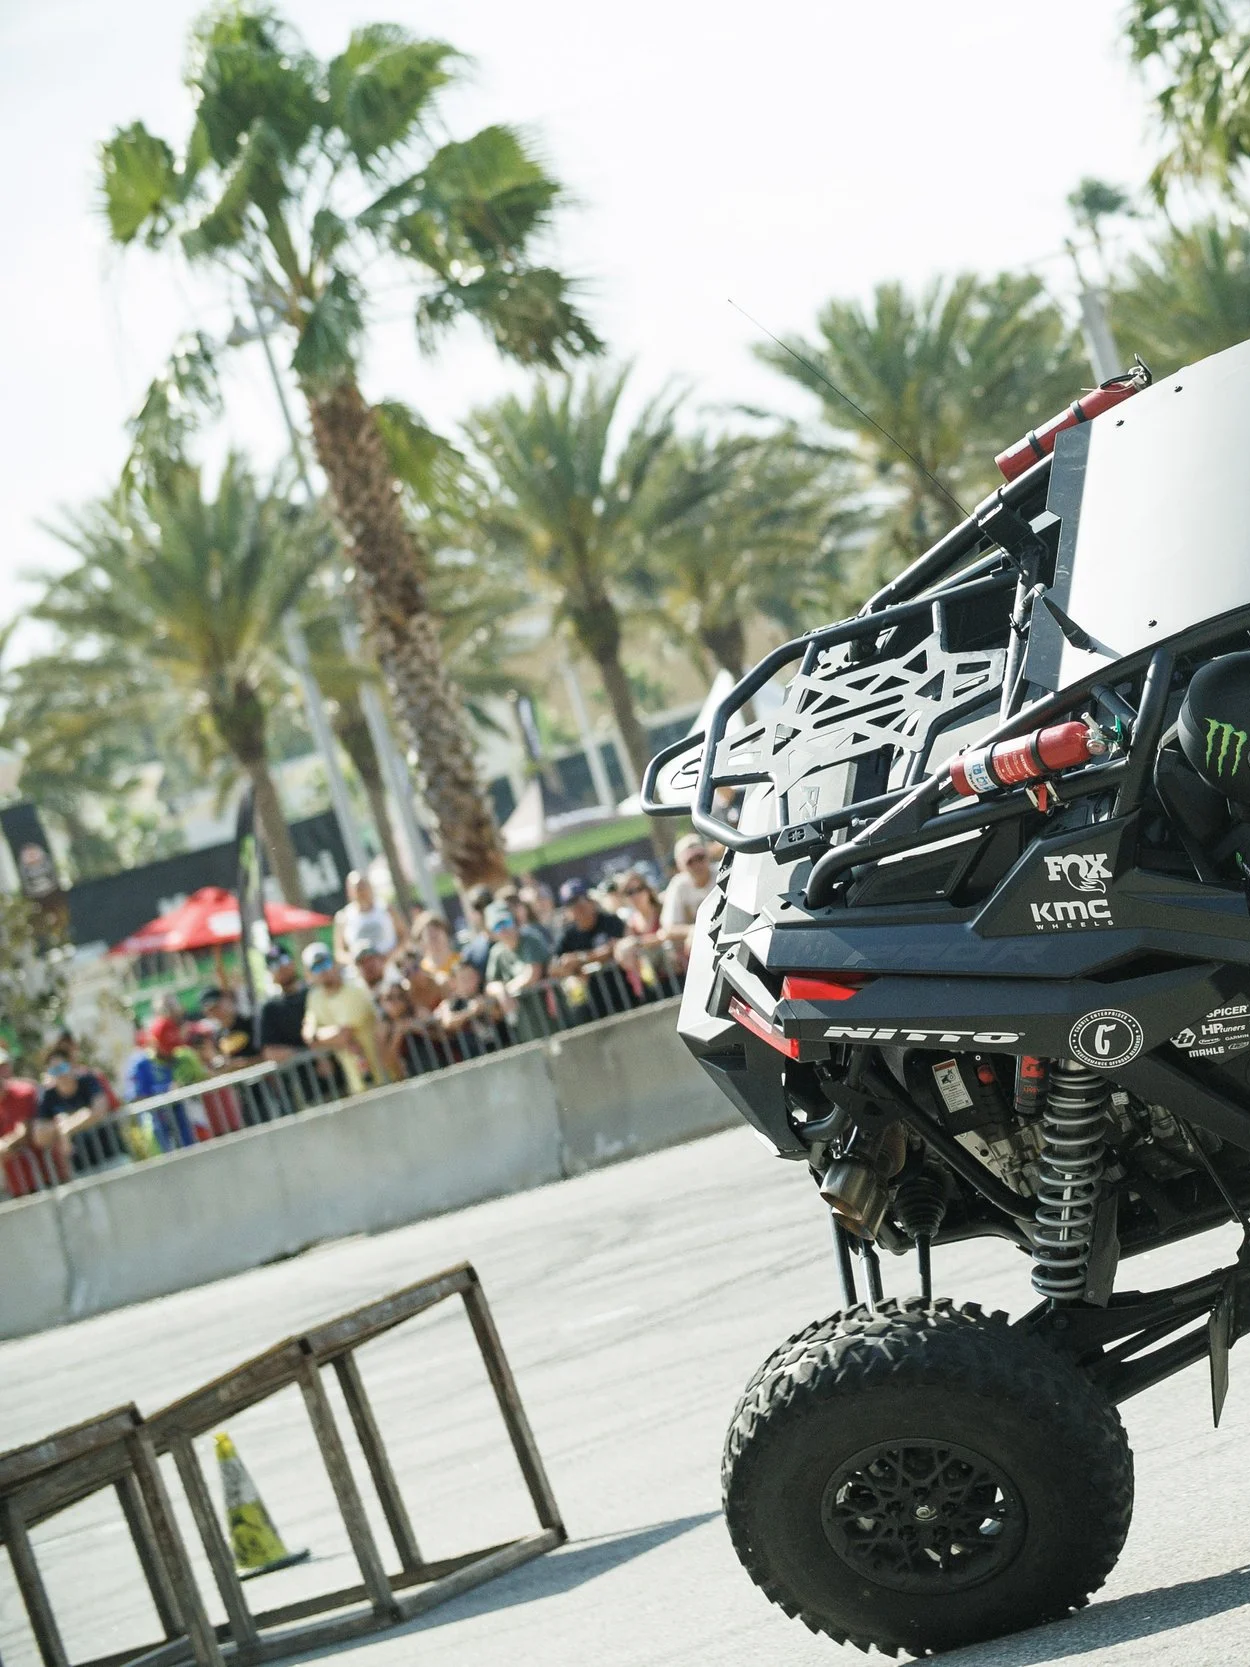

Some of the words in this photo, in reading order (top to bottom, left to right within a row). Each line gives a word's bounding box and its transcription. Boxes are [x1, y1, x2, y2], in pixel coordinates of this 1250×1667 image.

[1043, 853, 1113, 893] FOX
[1030, 899, 1112, 922] KMC
[1036, 920, 1114, 930] WHEELS
[1206, 1005, 1247, 1018] SPICER
[823, 1026, 1020, 1044] NITTO
[1076, 1049, 1108, 1066] PERFORMANCE
[1188, 1046, 1225, 1058] MAHLE
